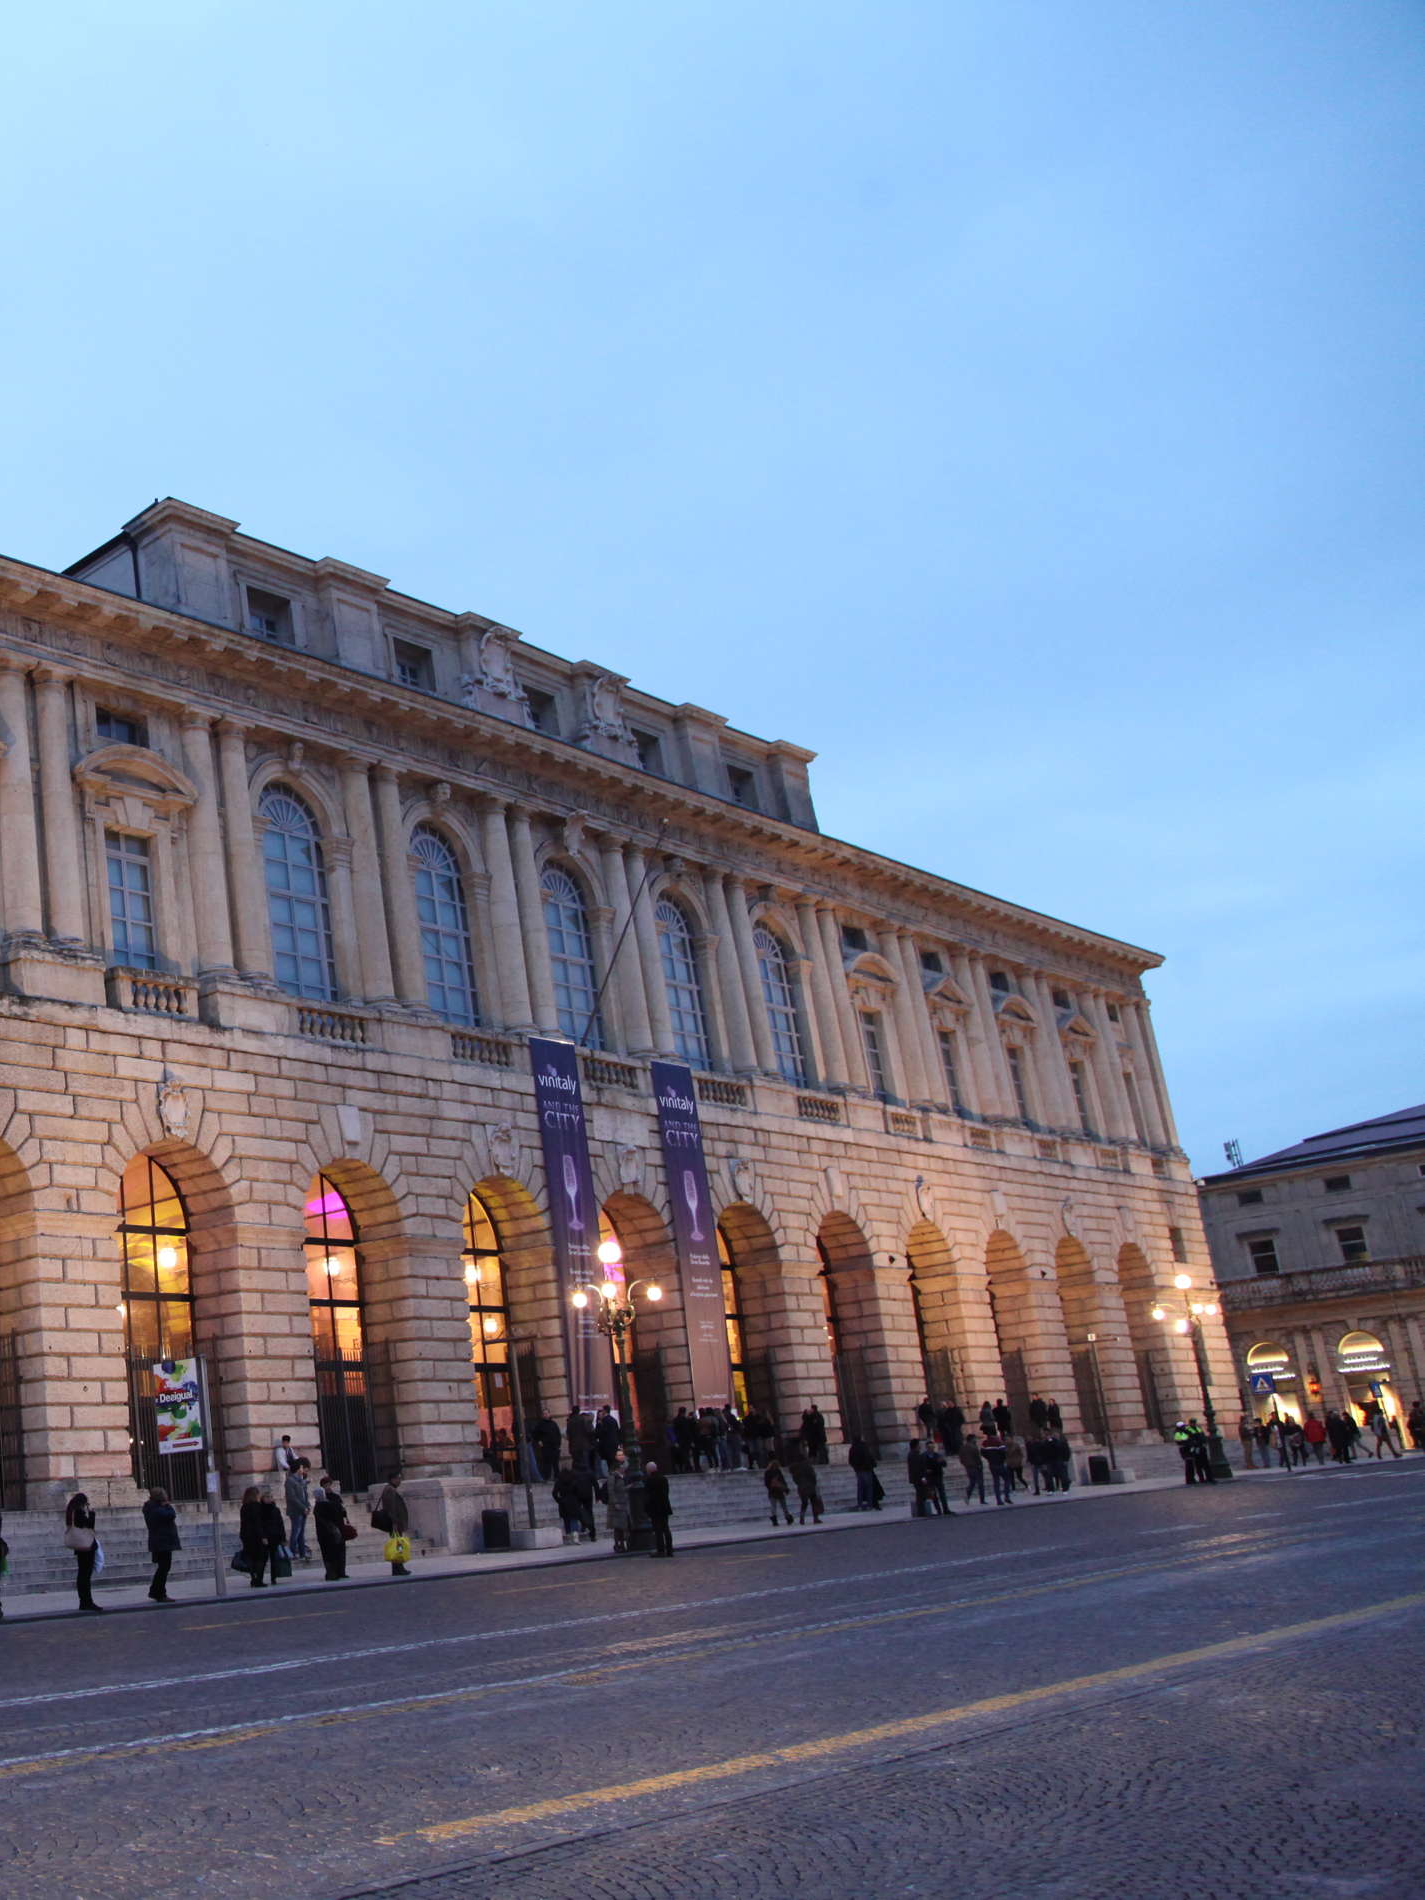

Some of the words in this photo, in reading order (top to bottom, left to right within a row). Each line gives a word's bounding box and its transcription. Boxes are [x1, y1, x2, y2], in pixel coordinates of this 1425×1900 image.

[538, 1074, 576, 1095] vinitaly
[543, 1100, 561, 1110] AND
[564, 1103, 580, 1113] THE
[659, 1095, 694, 1115] vinitaly
[544, 1110, 580, 1132] CITY
[664, 1120, 681, 1129] AND
[666, 1129, 698, 1149] CITY
[159, 1390, 193, 1403] Desigual
